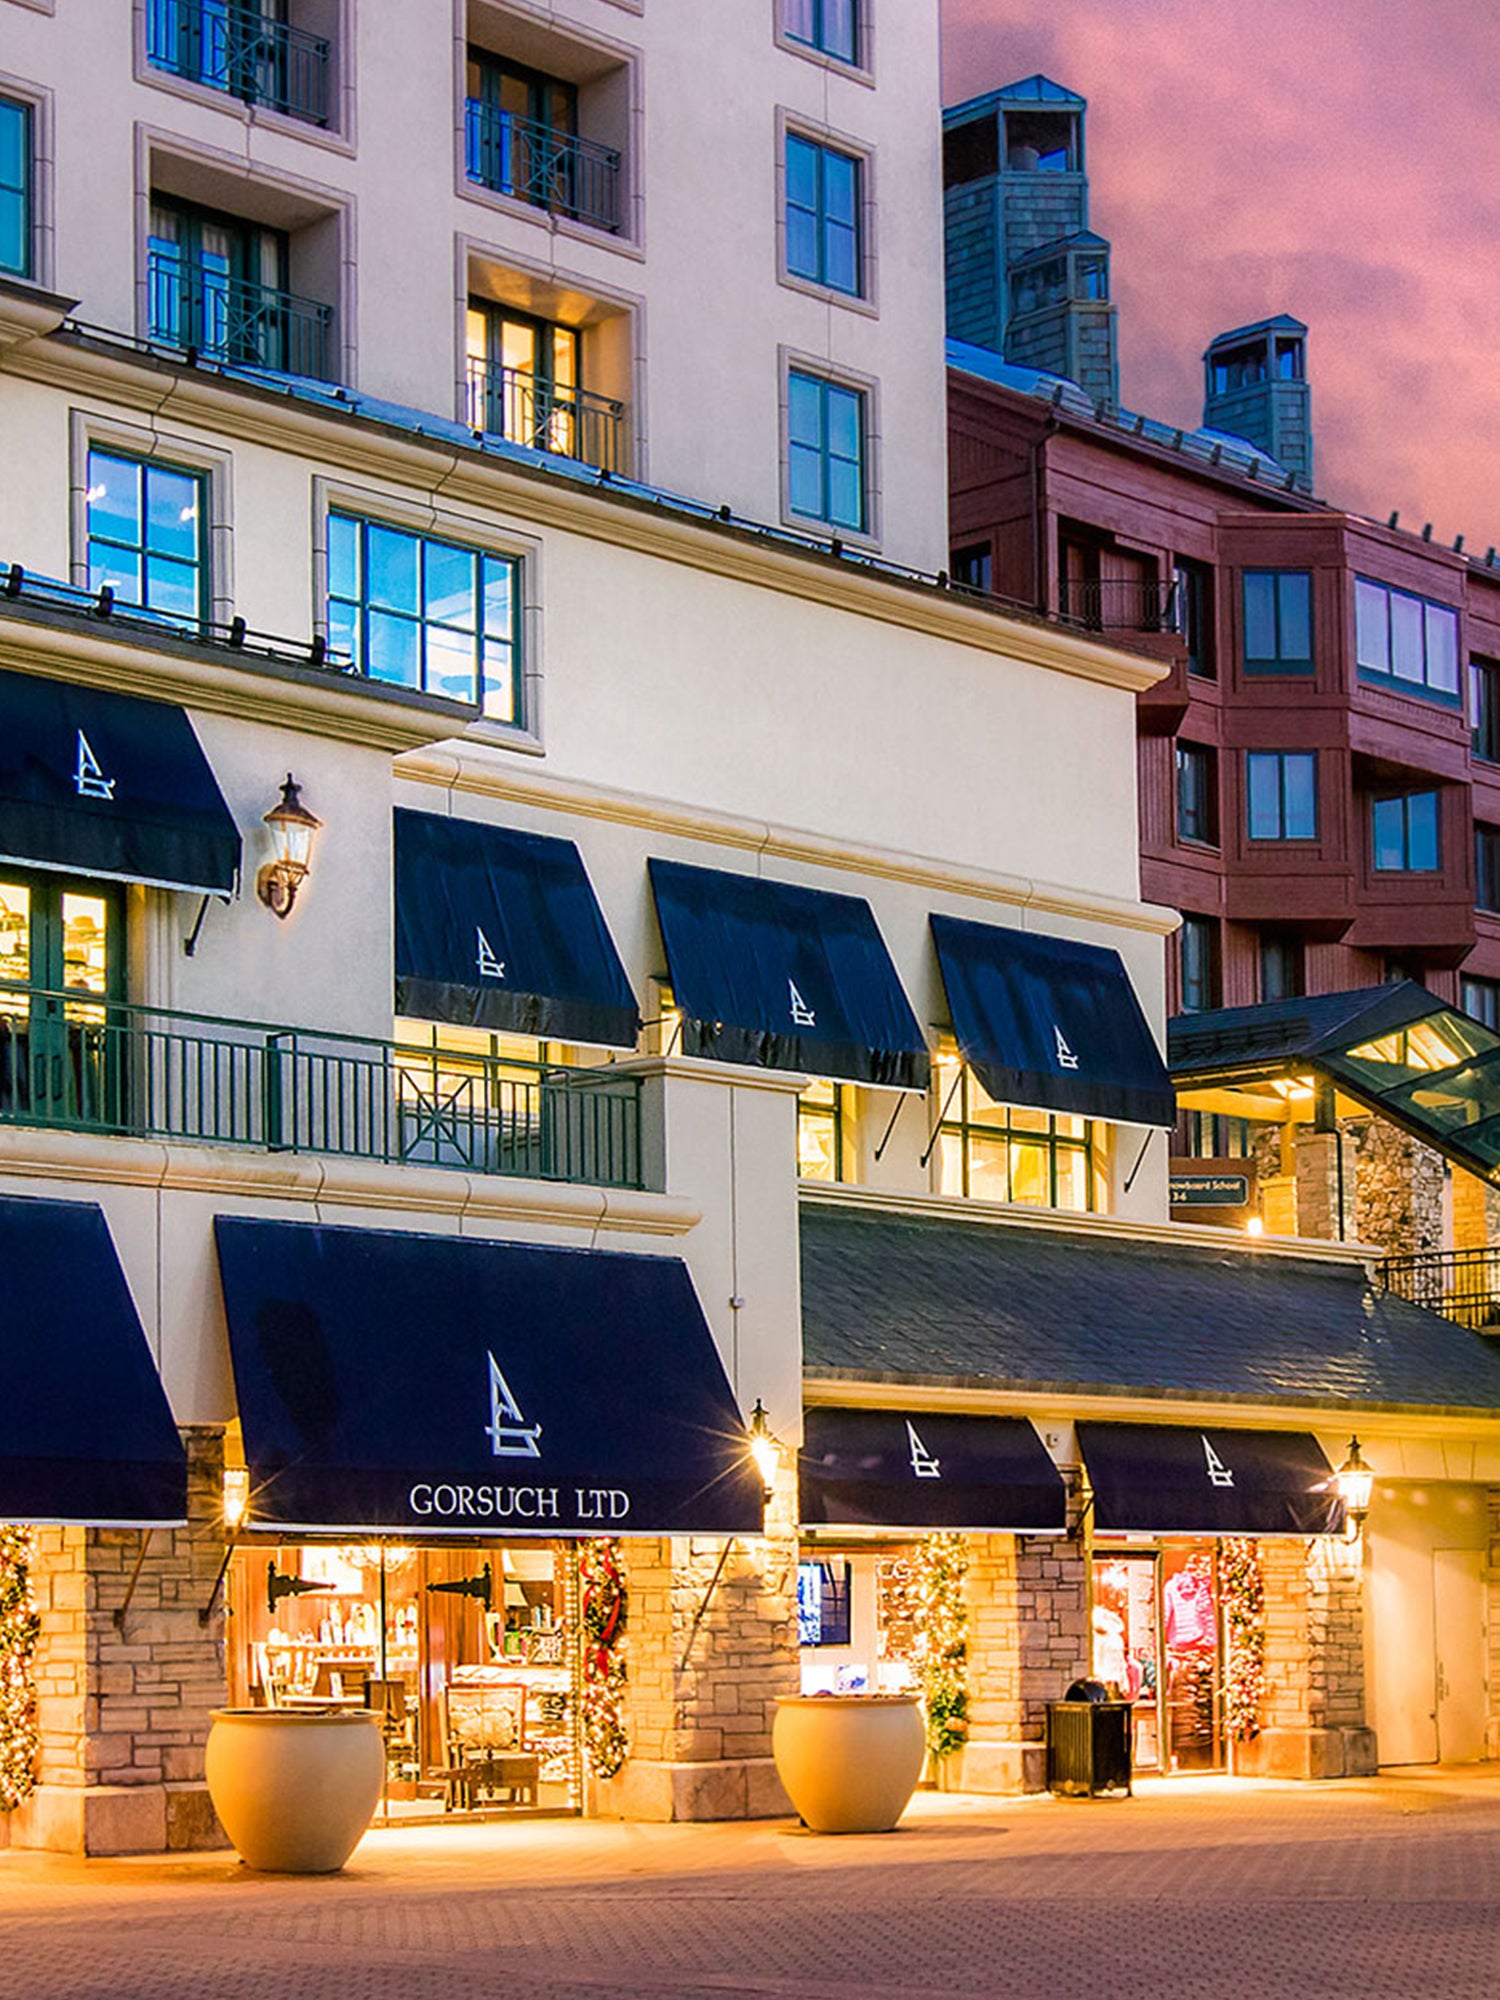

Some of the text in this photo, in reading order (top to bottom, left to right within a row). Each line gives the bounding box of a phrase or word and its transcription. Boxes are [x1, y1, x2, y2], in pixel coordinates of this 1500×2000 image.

[1212, 1180, 1240, 1191] School
[409, 1484, 631, 1519] GORSUCH LTD
